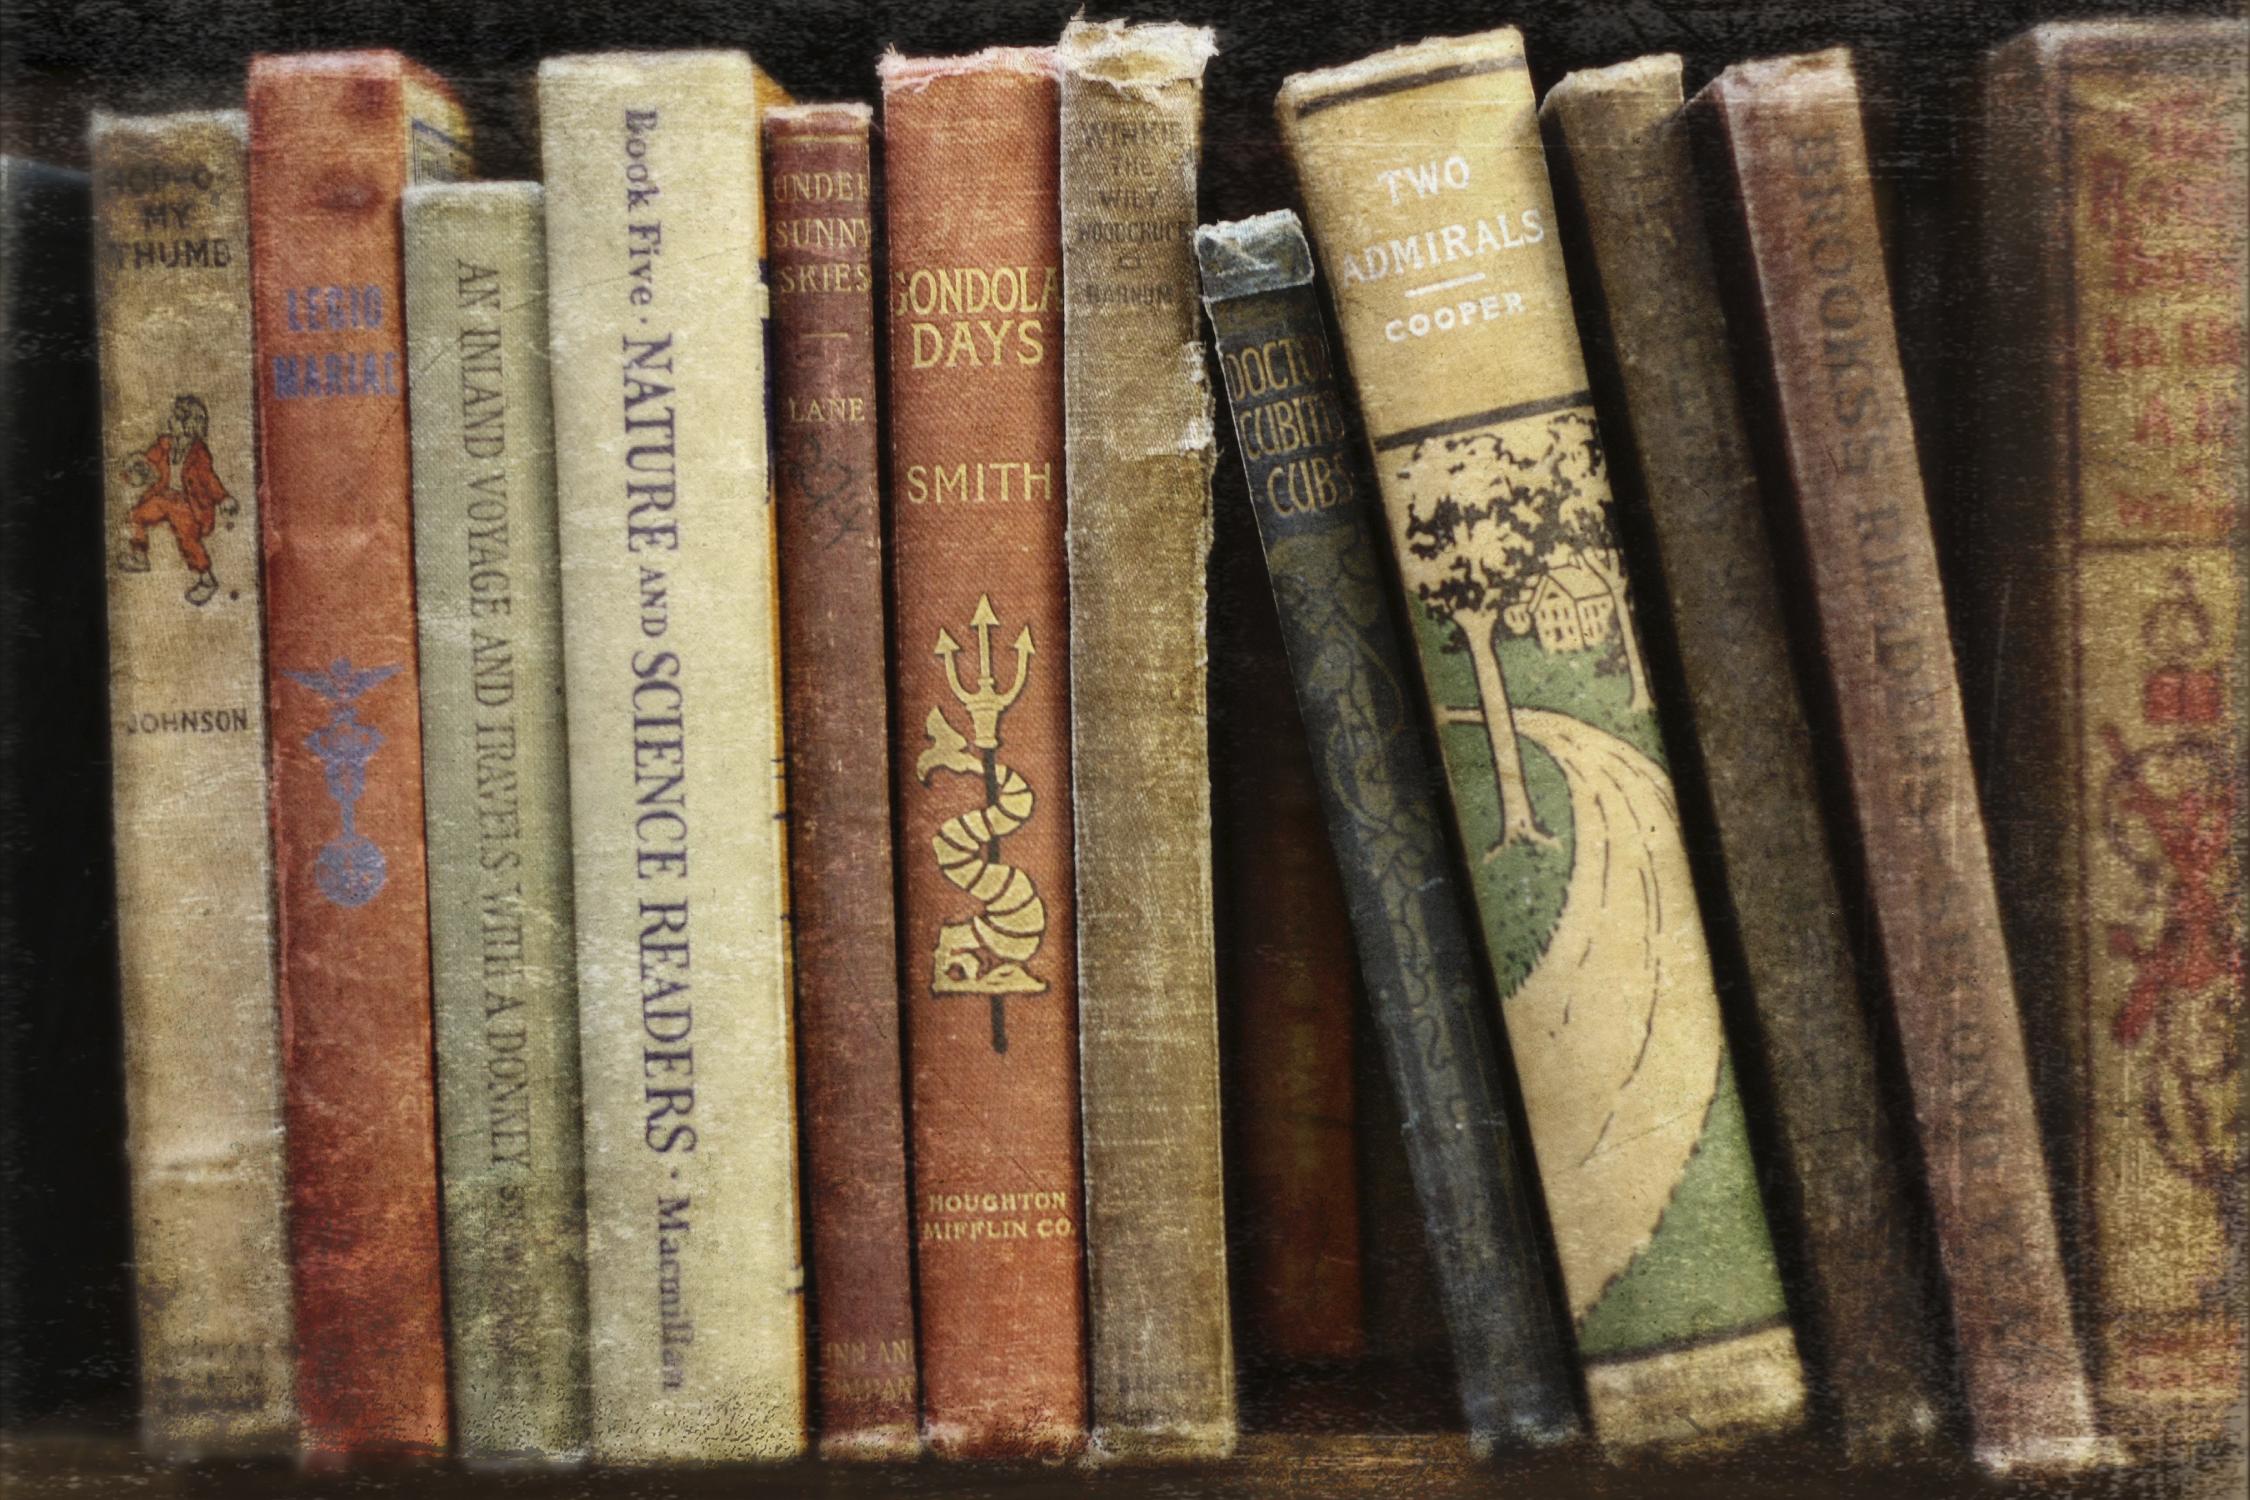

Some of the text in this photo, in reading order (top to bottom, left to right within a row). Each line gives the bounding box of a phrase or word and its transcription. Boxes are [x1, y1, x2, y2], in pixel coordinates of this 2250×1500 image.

[1376, 154, 1471, 206] TWO
[142, 202, 193, 231] MY
[775, 217, 871, 249] SUNNY
[106, 238, 232, 270] THUMB
[1343, 208, 1545, 289] ADMIRALS
[458, 259, 500, 309] AN
[779, 263, 872, 292] SKIES
[286, 283, 383, 332] LEGIO
[1384, 291, 1526, 342] COOPER
[911, 319, 1044, 369] DAYS
[460, 328, 505, 459] INLAND
[788, 396, 865, 423] LANE
[907, 461, 1051, 505] SMITH
[466, 473, 512, 618] VOYAGE
[471, 629, 514, 707] AND
[126, 708, 248, 736] JOHNSON
[622, 106, 698, 1391] Book Five NATURE AND SCIENCE READERS Macmillan
[475, 719, 520, 873] TRAVELS
[482, 881, 524, 979] WITH
[485, 999, 526, 1020] A
[486, 1026, 531, 1170] DONKEY
[928, 1191, 1067, 1213] HOUGHTON
[923, 1219, 1028, 1241] MIFFLIN
